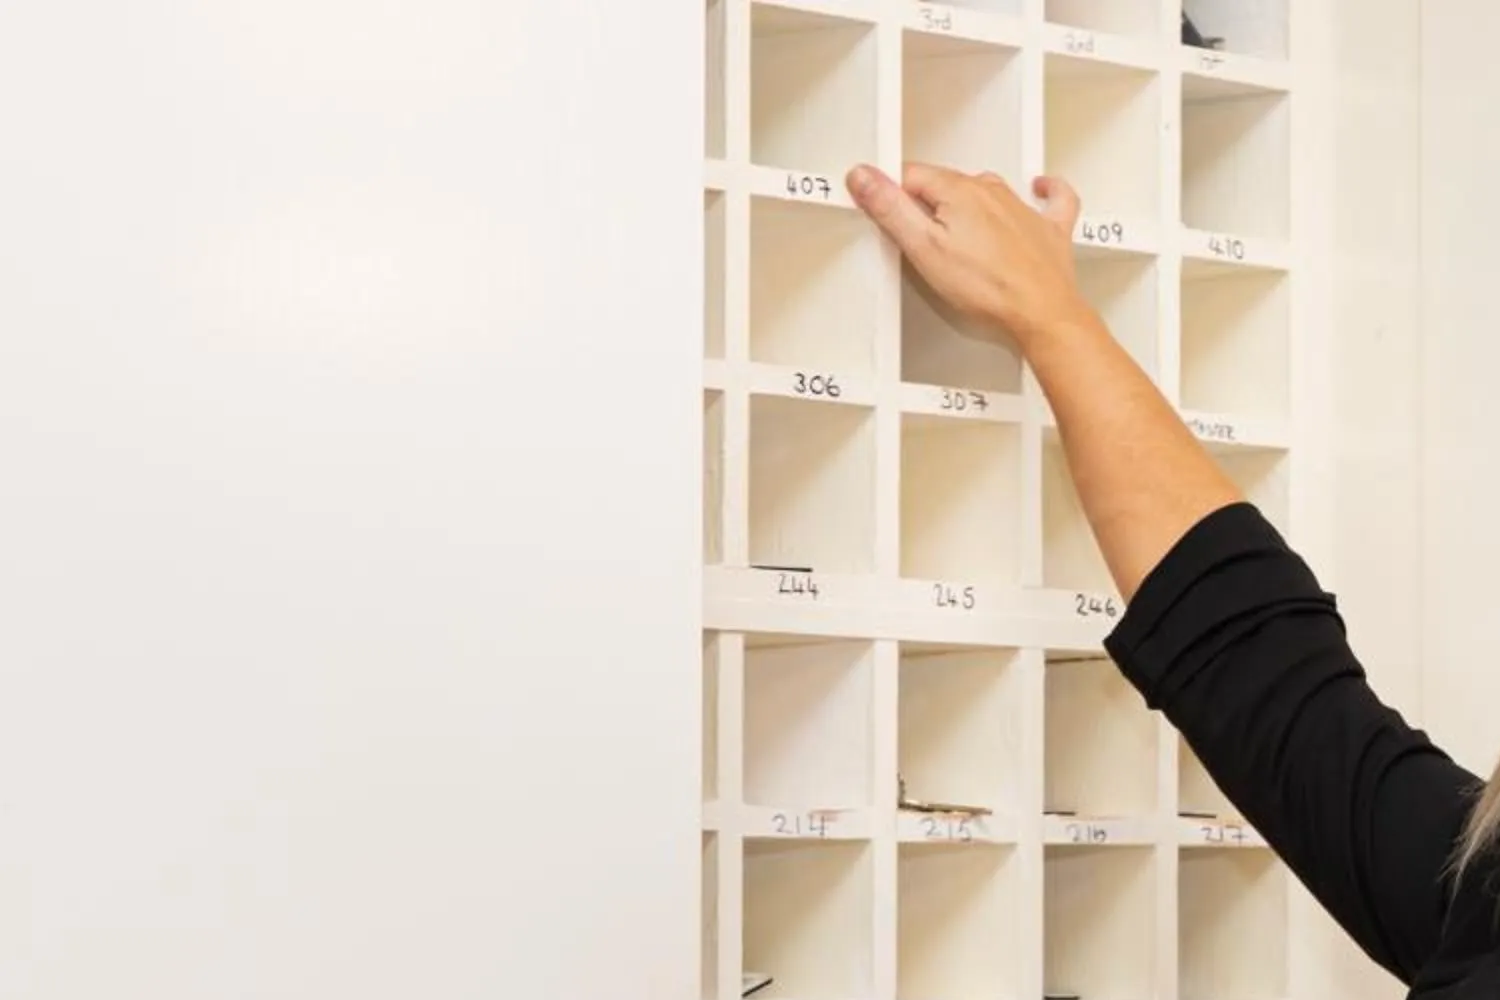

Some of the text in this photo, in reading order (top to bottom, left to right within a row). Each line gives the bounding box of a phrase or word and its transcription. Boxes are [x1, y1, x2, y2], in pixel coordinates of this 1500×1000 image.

[919, 8, 952, 31] 3rd
[785, 175, 832, 199] 407
[1082, 221, 1124, 243] 409
[1208, 239, 1245, 260] 410
[793, 372, 841, 397] 306
[941, 392, 988, 412] 307
[778, 573, 819, 598] 244
[934, 583, 975, 611] 245
[1075, 594, 1117, 618] 246
[771, 814, 828, 837] 214
[922, 817, 973, 842] 215
